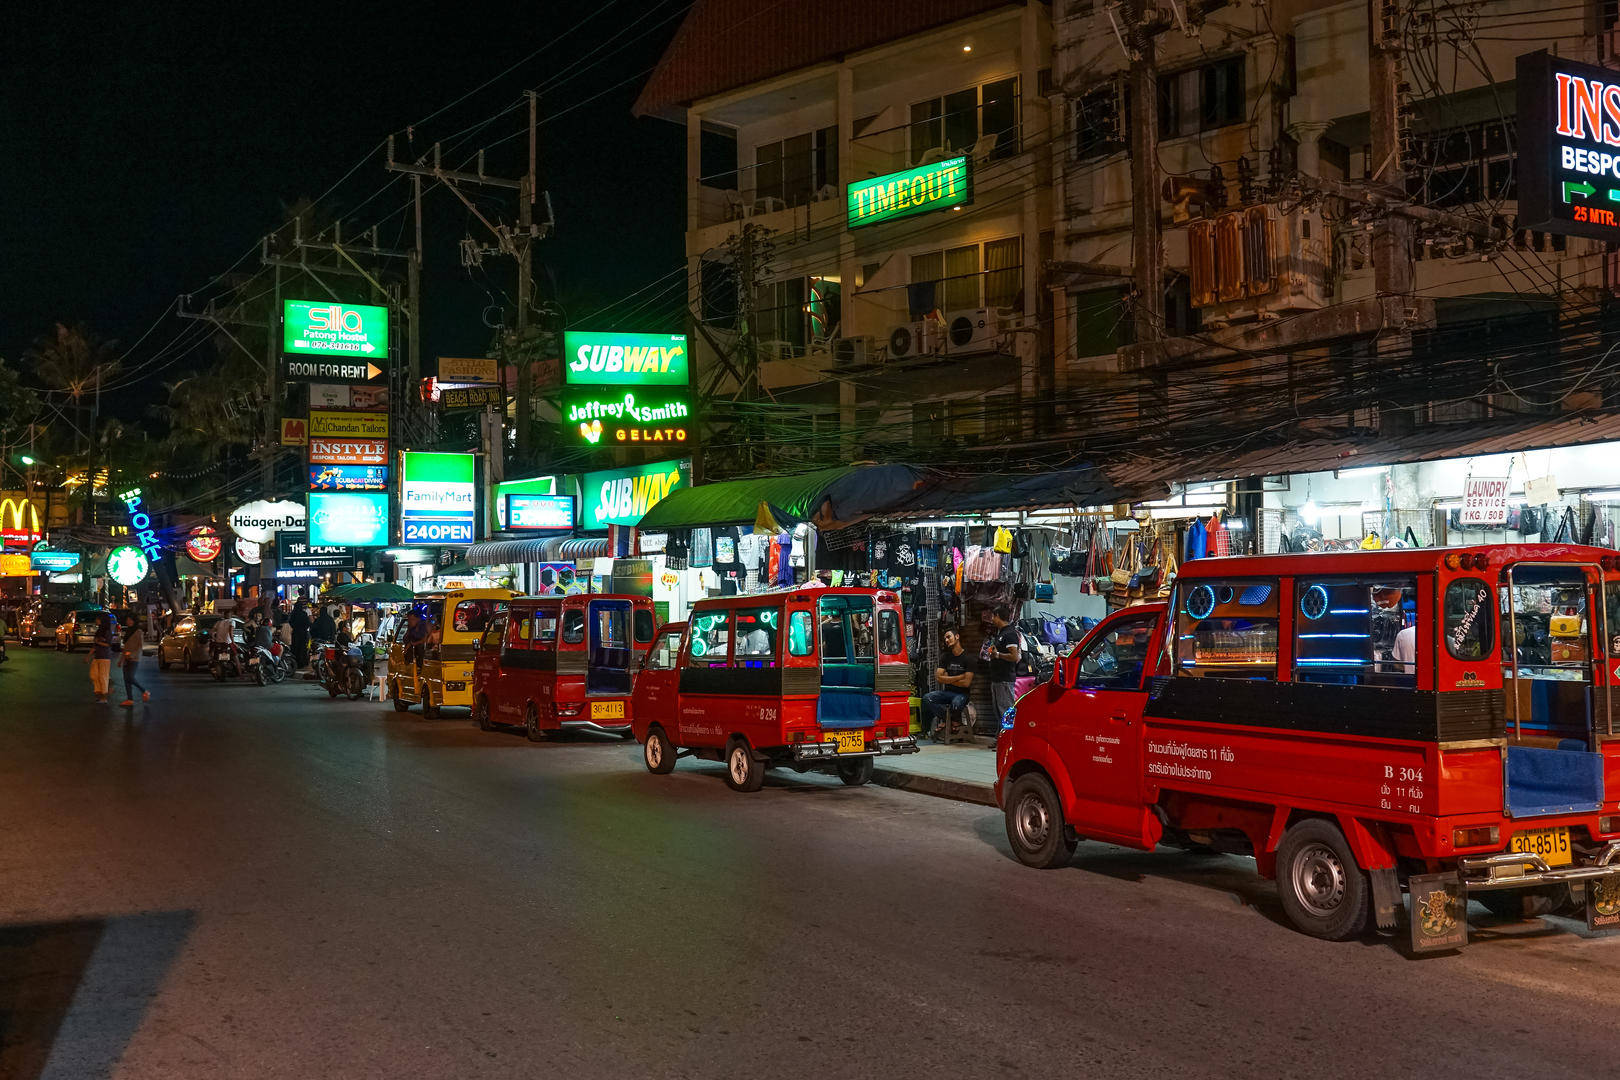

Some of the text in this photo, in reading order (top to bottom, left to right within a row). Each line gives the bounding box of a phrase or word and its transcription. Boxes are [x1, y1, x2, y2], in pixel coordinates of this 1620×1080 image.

[854, 166, 959, 218] TIMEOUT
[1574, 206, 1617, 226] 25 MTR.
[303, 330, 368, 342] Patong Hostel
[570, 344, 684, 373] SUBWAY
[289, 362, 366, 378] ROOM FOR RENT
[446, 392, 468, 403] BEACH
[469, 392, 487, 402] ROAD
[570, 401, 624, 420] Jeffrey
[641, 402, 688, 422] Smith
[328, 422, 386, 433] Chandan Tailors
[616, 429, 686, 440] GELATO
[312, 443, 385, 454] INSTYLE
[119, 488, 142, 501] THE
[594, 468, 680, 522] SUBWAY
[1467, 480, 1508, 498] LAUNDRY
[407, 490, 472, 504] FamilyMart
[1466, 498, 1506, 508] SERVICE
[124, 496, 162, 562] PORT
[289, 543, 306, 554] THE
[1478, 589, 1487, 604] 40
[593, 704, 622, 713] 30-4113
[765, 708, 776, 720] 294
[1210, 749, 1218, 760] 11
[1220, 746, 1234, 762] ที่นั่ง
[1384, 766, 1424, 782] B 304
[1396, 788, 1404, 796] 11
